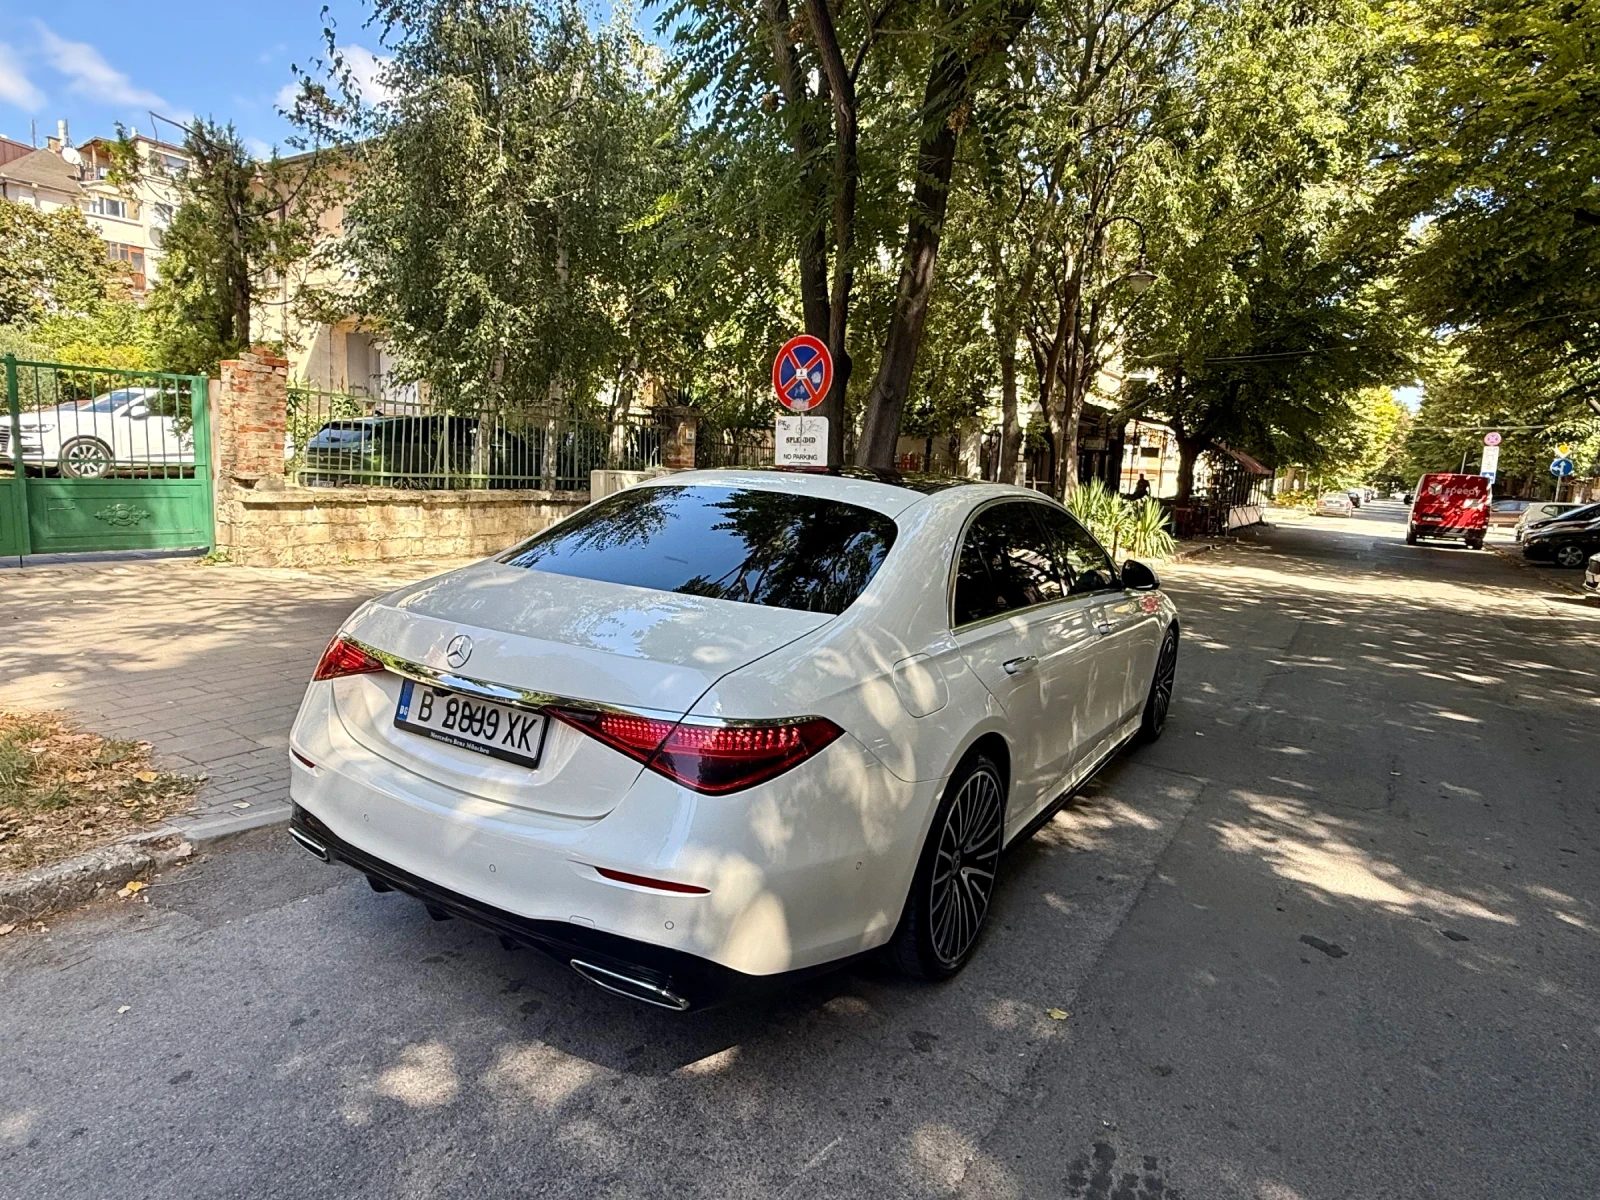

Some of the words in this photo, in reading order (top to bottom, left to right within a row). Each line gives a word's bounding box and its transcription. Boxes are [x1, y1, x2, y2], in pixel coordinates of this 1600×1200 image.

[1445, 486, 1481, 496] speedy
[399, 705, 409, 716] BG
[418, 690, 434, 722] B
[501, 712, 537, 752] XK
